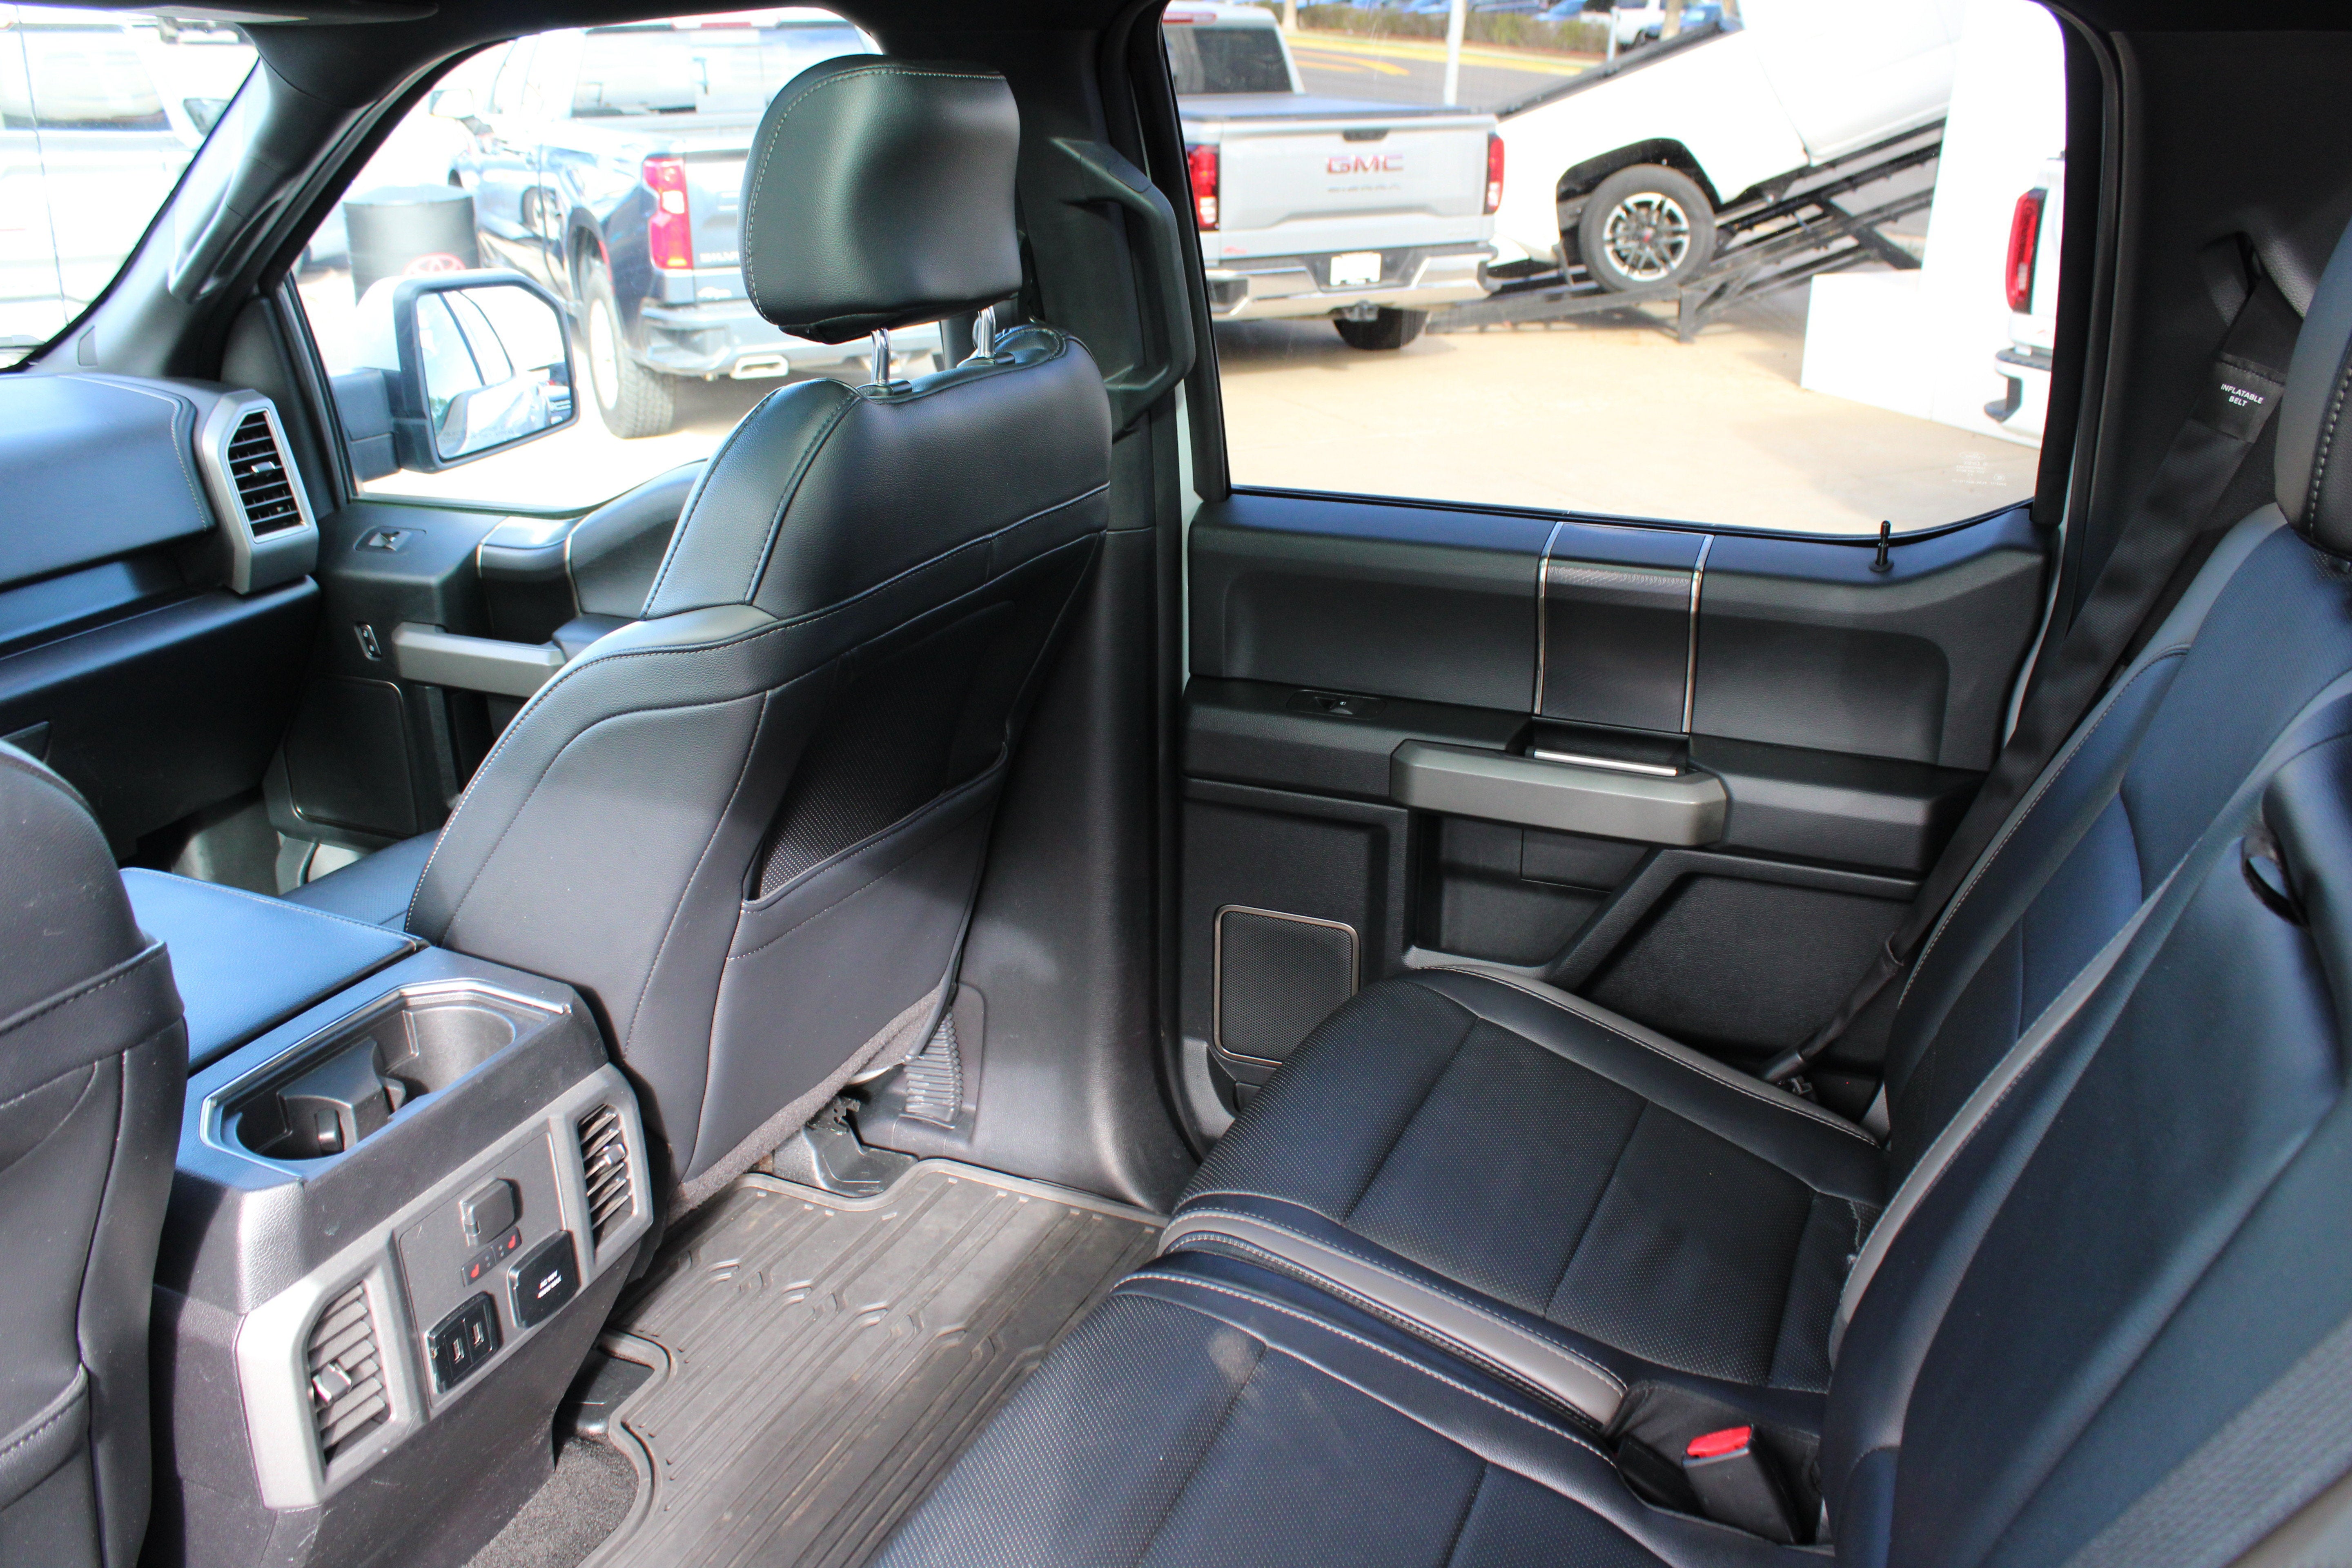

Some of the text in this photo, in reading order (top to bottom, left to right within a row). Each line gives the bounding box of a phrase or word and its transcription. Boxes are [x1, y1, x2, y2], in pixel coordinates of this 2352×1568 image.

[1327, 154, 1404, 174] GMC
[2221, 383, 2264, 405] INFLATABLE
[2228, 395, 2247, 407] BELT
